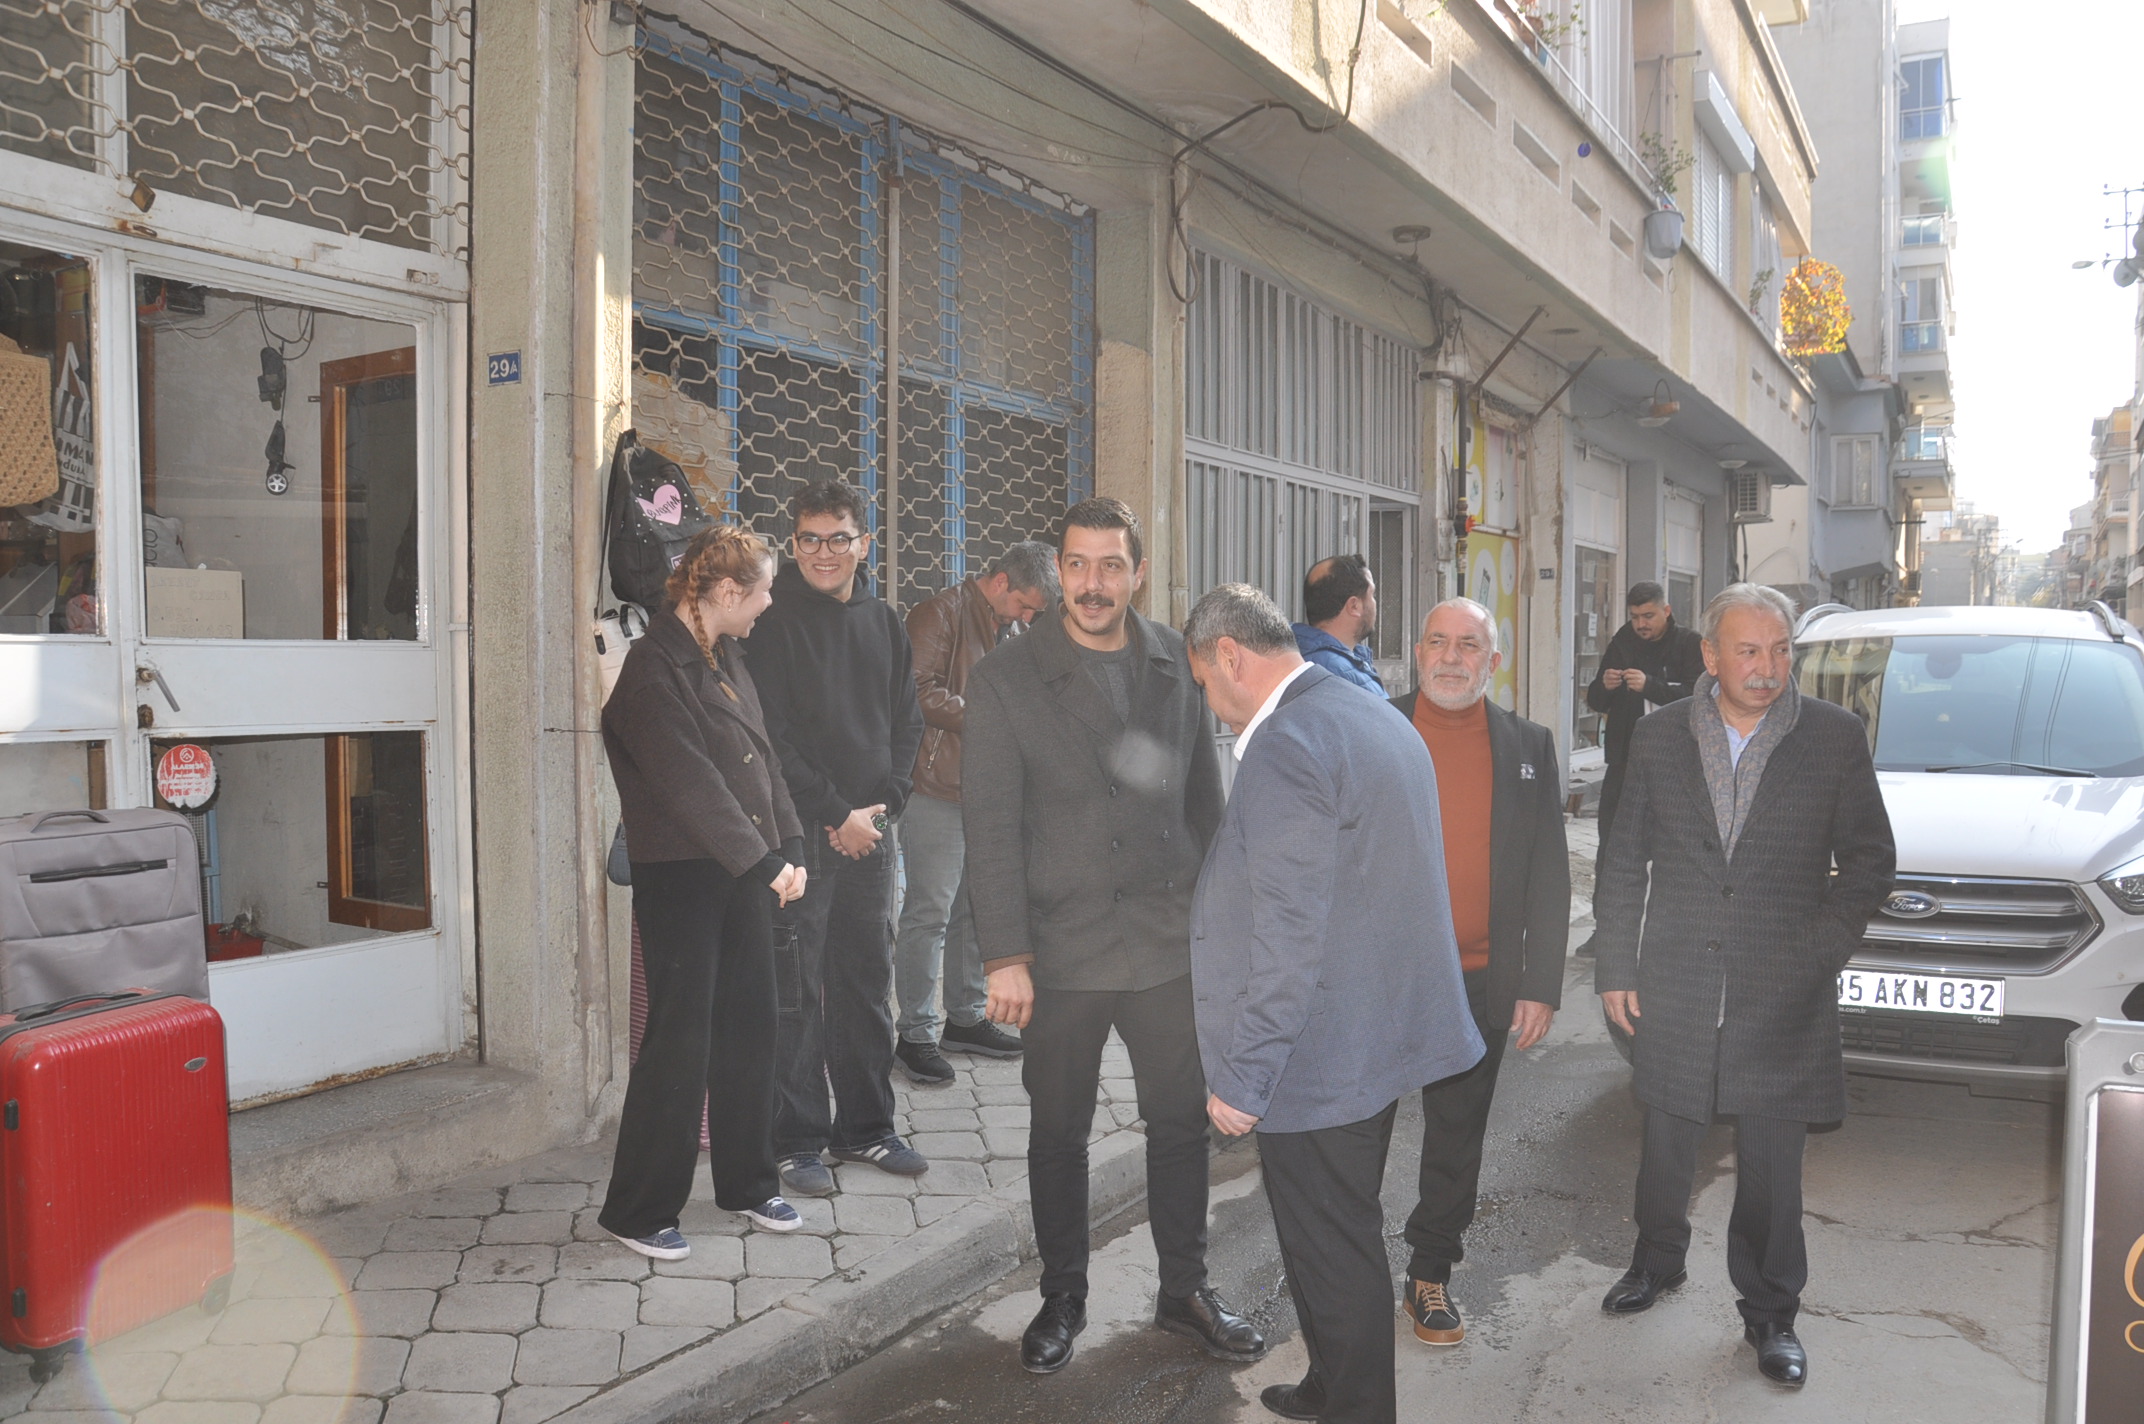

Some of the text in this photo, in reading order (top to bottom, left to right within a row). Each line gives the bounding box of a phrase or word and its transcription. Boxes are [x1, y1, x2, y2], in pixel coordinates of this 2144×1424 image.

[1891, 896, 1925, 911] Ford
[1874, 977, 1928, 1007] AKN
[1940, 982, 1995, 1012] 832
